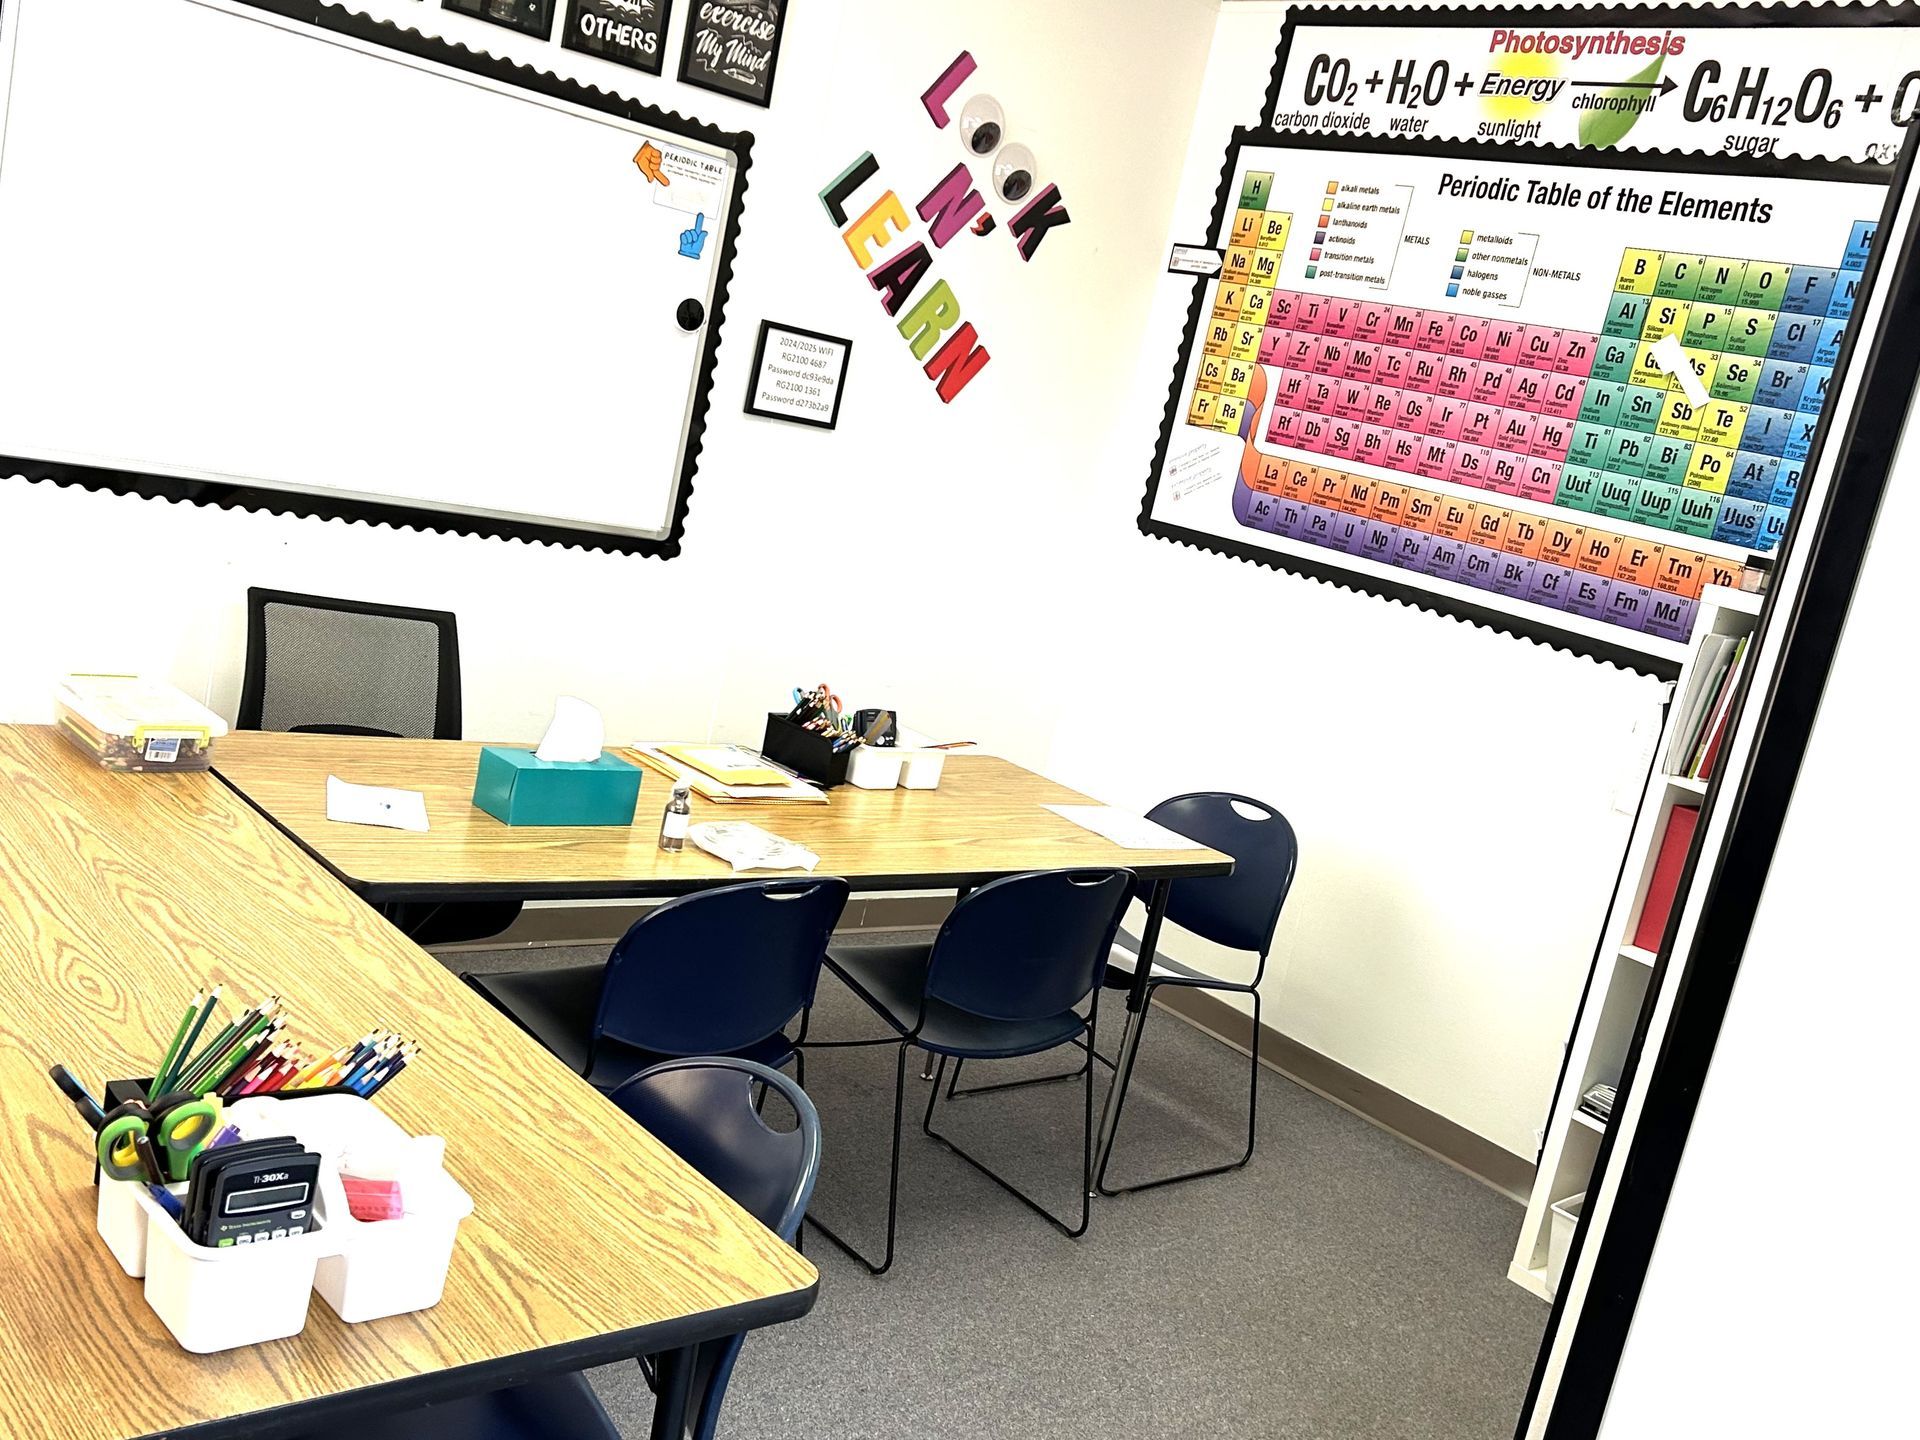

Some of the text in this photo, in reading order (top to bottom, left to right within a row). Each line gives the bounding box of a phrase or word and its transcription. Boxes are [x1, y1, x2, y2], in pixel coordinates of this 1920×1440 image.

[700, 2, 775, 41] exercise
[580, 14, 657, 54] OTHERS
[696, 30, 771, 72] My Mind
[1489, 30, 1685, 58] Photosynthesis
[1480, 73, 1566, 104] Energy
[1571, 93, 1656, 114] chlorophyll
[1275, 112, 1370, 129] carbon dioxide
[1390, 116, 1429, 132] water
[1477, 120, 1541, 142] sunlight
[1723, 134, 1779, 154] sugar
[665, 152, 697, 167] PERIODIC
[701, 162, 722, 174] TABLE
[1252, 181, 1262, 194] H
[1341, 185, 1380, 195] alkali metals
[1438, 173, 1773, 224] Periodic Table of the Elements
[1337, 201, 1400, 214] alkaline earth metals
[1242, 218, 1253, 232] Li
[1268, 221, 1282, 235] Be
[1332, 218, 1367, 228] lanthanoids
[1328, 235, 1355, 245] actinoids
[1404, 235, 1430, 245] METALS
[1476, 233, 1513, 245] metalloids
[1231, 254, 1245, 268] Na
[1257, 257, 1275, 274] Mg
[1324, 251, 1374, 264] transition metals
[1472, 252, 1528, 266] other nonmetals
[1533, 267, 1581, 281] NON-METALS
[1634, 259, 1646, 274] B
[1675, 263, 1687, 279] C
[818, 150, 991, 404] LEARN
[1319, 269, 1385, 284] post-transition metals
[1467, 269, 1498, 281] halogens
[1716, 268, 1729, 284] N
[1760, 272, 1772, 289] O
[1804, 277, 1818, 293] F
[1226, 291, 1234, 304] K
[1462, 287, 1507, 300] noble gasses
[1250, 295, 1263, 309] Ca
[1277, 300, 1291, 314] Sc
[1309, 304, 1318, 318] Ti
[1339, 308, 1348, 322] V
[1619, 303, 1637, 319] Al
[1659, 308, 1676, 325] Si
[1366, 312, 1380, 327] Cr
[1394, 316, 1414, 332] Mn
[1703, 313, 1716, 329] P
[1745, 318, 1758, 335] S
[1214, 328, 1228, 341] Rb
[1428, 321, 1443, 336] Fe
[1460, 326, 1478, 342] Co
[1787, 324, 1806, 341] Cl
[780, 337, 816, 352] 2024/2025
[1241, 332, 1254, 346] Sr
[1272, 337, 1280, 350] Y
[1496, 331, 1512, 347] Ni
[1530, 336, 1549, 353] Cu
[1297, 342, 1310, 355] Zr
[1324, 346, 1341, 361] Nb
[1567, 342, 1586, 358] Zn
[1605, 346, 1625, 363] Ga
[1353, 351, 1372, 366] Mo
[1387, 356, 1401, 372] Tc
[768, 364, 800, 377] Password
[1232, 368, 1245, 382] Ba
[1417, 361, 1433, 377] Ru
[1449, 367, 1467, 383] Rh
[1727, 364, 1748, 382] Se
[1288, 379, 1301, 393] Hf
[1483, 372, 1501, 389] Pd
[1772, 370, 1792, 389] Br
[1317, 384, 1329, 399] Ta
[1518, 378, 1538, 398] Ag
[1555, 384, 1575, 401] Cd
[762, 392, 794, 405] Password
[1347, 389, 1360, 404] W
[1375, 395, 1391, 411] Re
[1595, 390, 1610, 406] In
[1198, 399, 1209, 412] Fr
[1222, 404, 1236, 418] Ra
[1406, 401, 1422, 417] Os
[1631, 396, 1652, 414] Sn
[1672, 402, 1692, 420] Sb
[1442, 407, 1453, 422] Ir
[1474, 413, 1490, 429] Pt
[1716, 410, 1733, 428] Te
[1278, 416, 1292, 430] Rf
[1305, 422, 1321, 436] Db
[1506, 420, 1526, 436] Au
[1335, 427, 1351, 446] Sg
[1365, 433, 1381, 450] Bh
[1543, 426, 1562, 446] Hg
[1396, 440, 1412, 456] Hs
[1427, 447, 1446, 463] Mt
[1619, 440, 1640, 457] Pb
[1660, 447, 1679, 465] Bi
[1461, 454, 1479, 470] Ds
[1496, 461, 1514, 479] Rg
[1700, 455, 1721, 472] Po
[1264, 465, 1278, 480] La
[1292, 471, 1308, 486] Ce
[1531, 467, 1551, 484] Cn
[1743, 463, 1764, 481] At
[1323, 479, 1337, 492] Pr
[1565, 475, 1592, 494] Uut
[1351, 485, 1368, 501] Nd
[1380, 492, 1400, 509] Pm
[1602, 482, 1631, 506] Uuq
[1411, 499, 1433, 516] Sm
[1640, 490, 1671, 513] Uup
[1681, 499, 1713, 520] Uuh
[1446, 507, 1464, 524] Eu
[1480, 514, 1500, 532] Gd
[1345, 523, 1355, 538] U
[1517, 522, 1534, 540] Tb
[1552, 532, 1572, 552] Dy
[1589, 540, 1610, 558] Ho
[1630, 550, 1648, 567] Er
[1503, 564, 1523, 582] Bk
[1668, 558, 1692, 578] Tm
[1542, 574, 1559, 591] Cf
[1578, 583, 1597, 600] Es
[1614, 592, 1638, 612] Fm
[1654, 602, 1680, 622] Md
